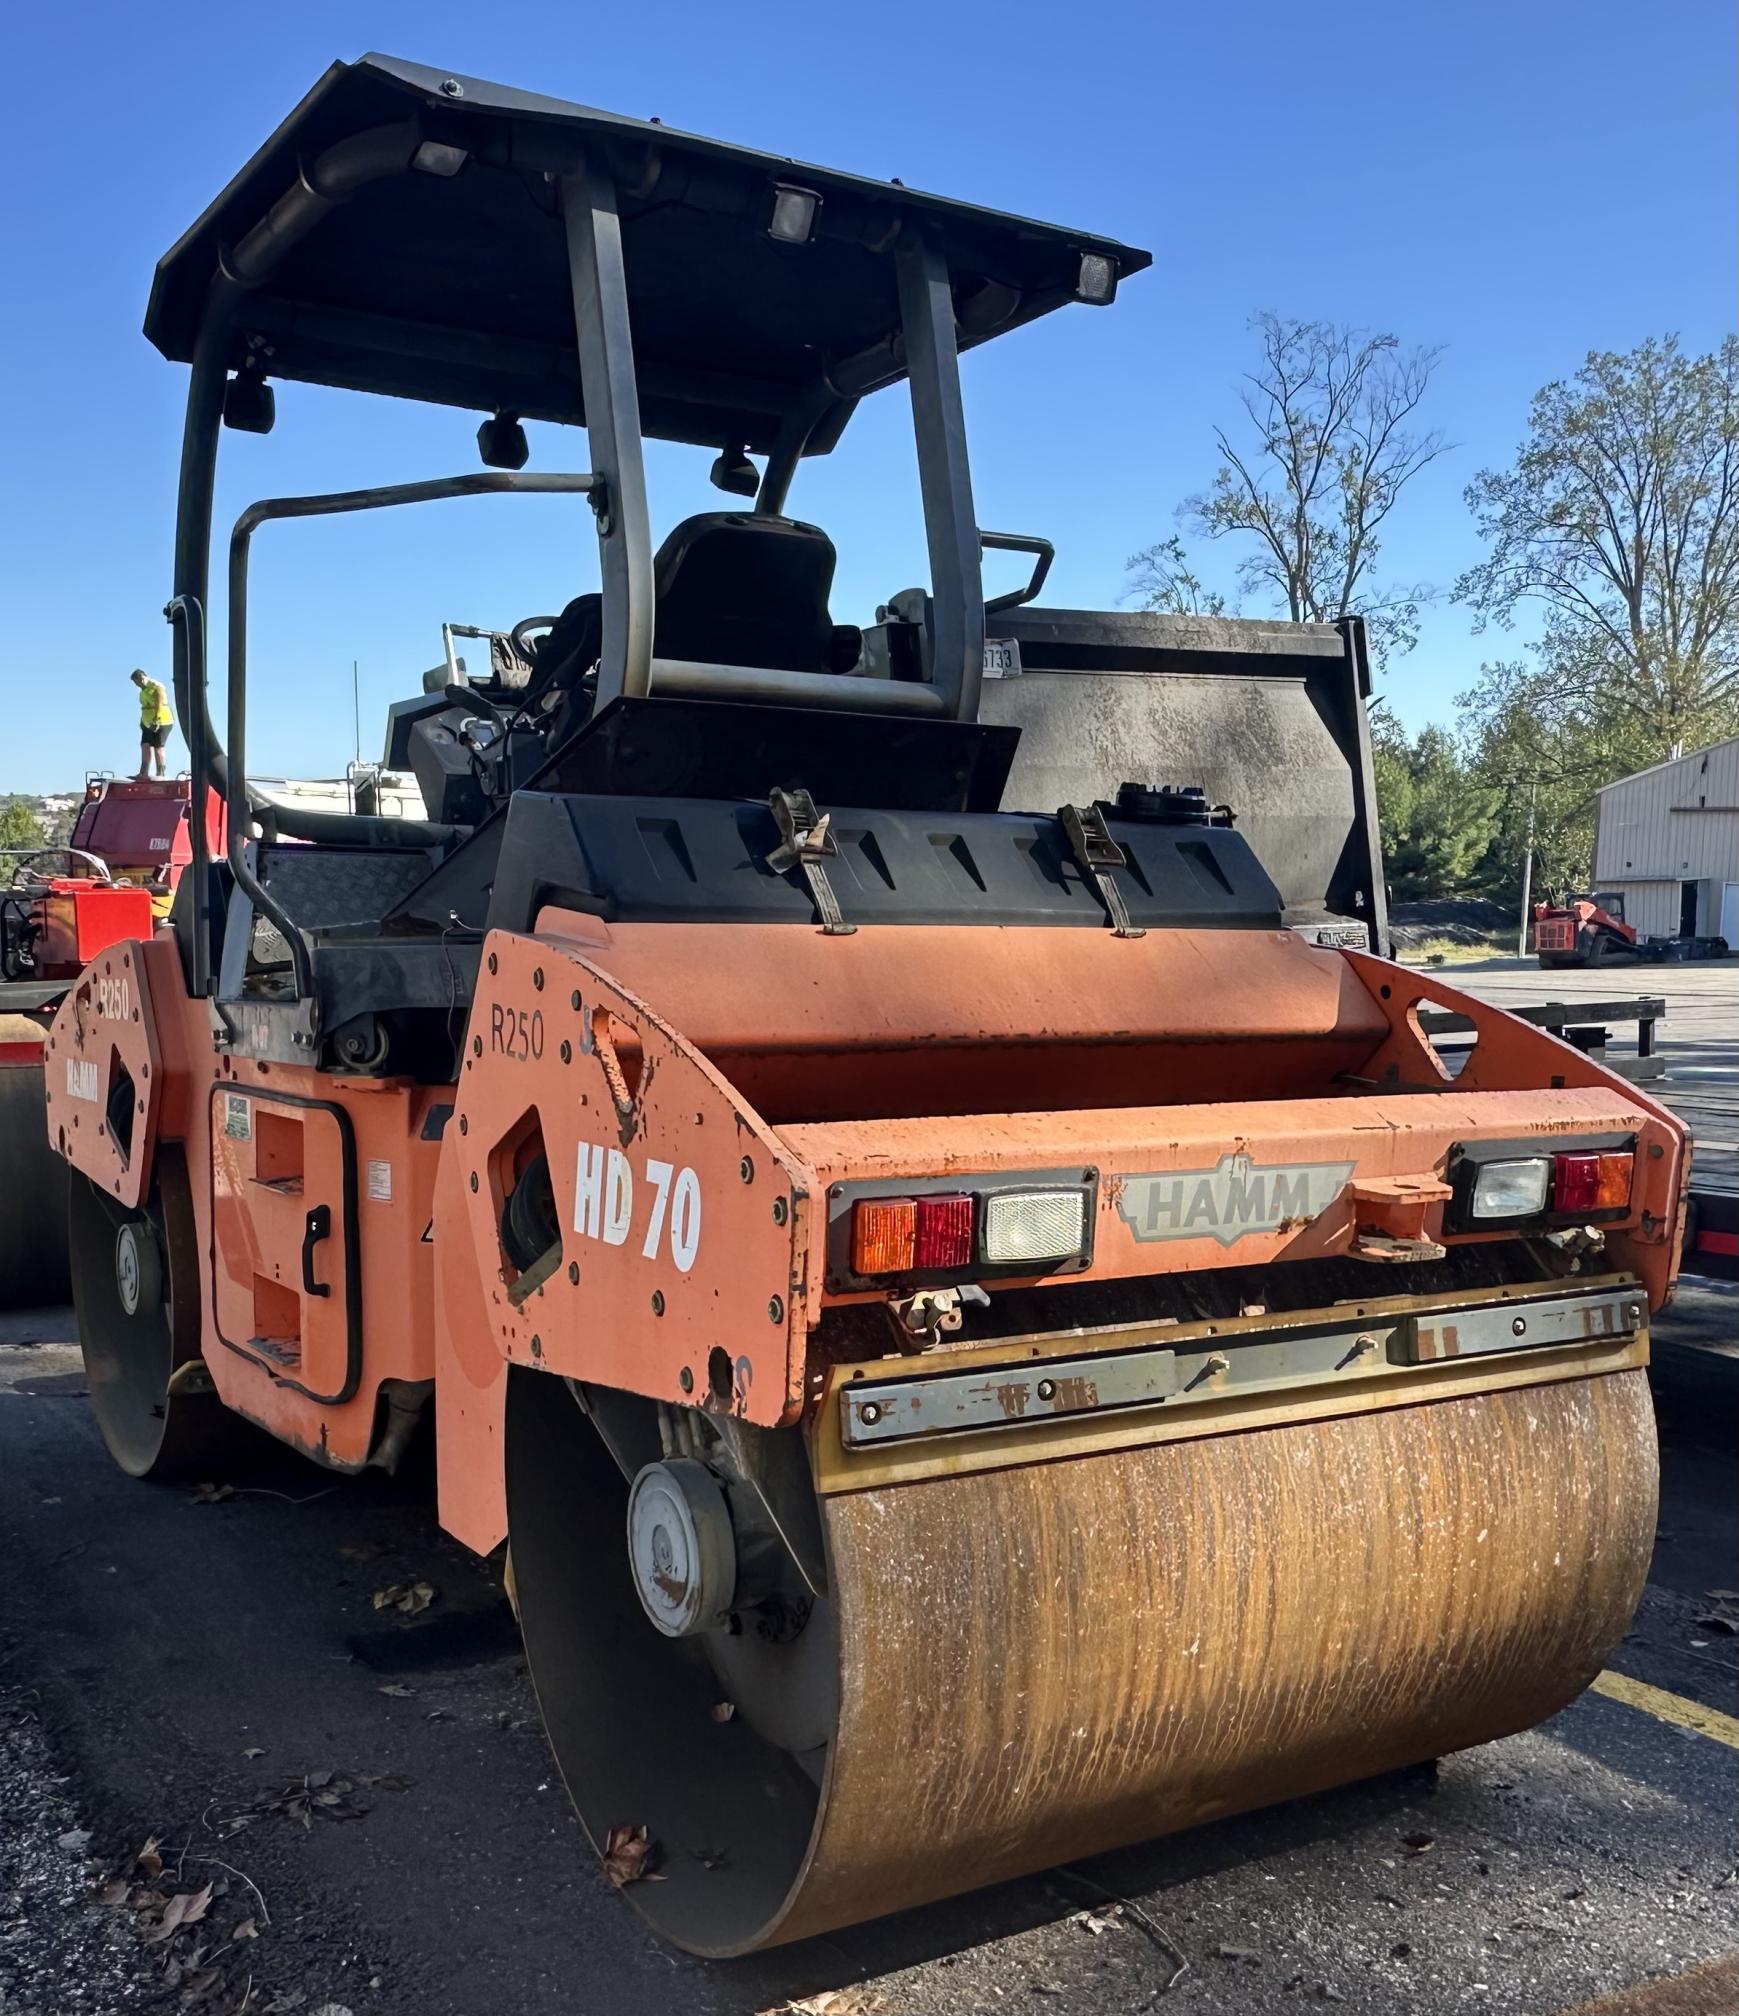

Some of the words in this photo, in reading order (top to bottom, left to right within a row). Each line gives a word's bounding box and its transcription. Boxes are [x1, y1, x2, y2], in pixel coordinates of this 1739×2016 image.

[99, 978, 129, 1020] R250
[492, 1003, 544, 1062] R250
[573, 1141, 633, 1246] HD
[642, 1158, 701, 1273] 70
[1147, 1173, 1310, 1230] HAMM
